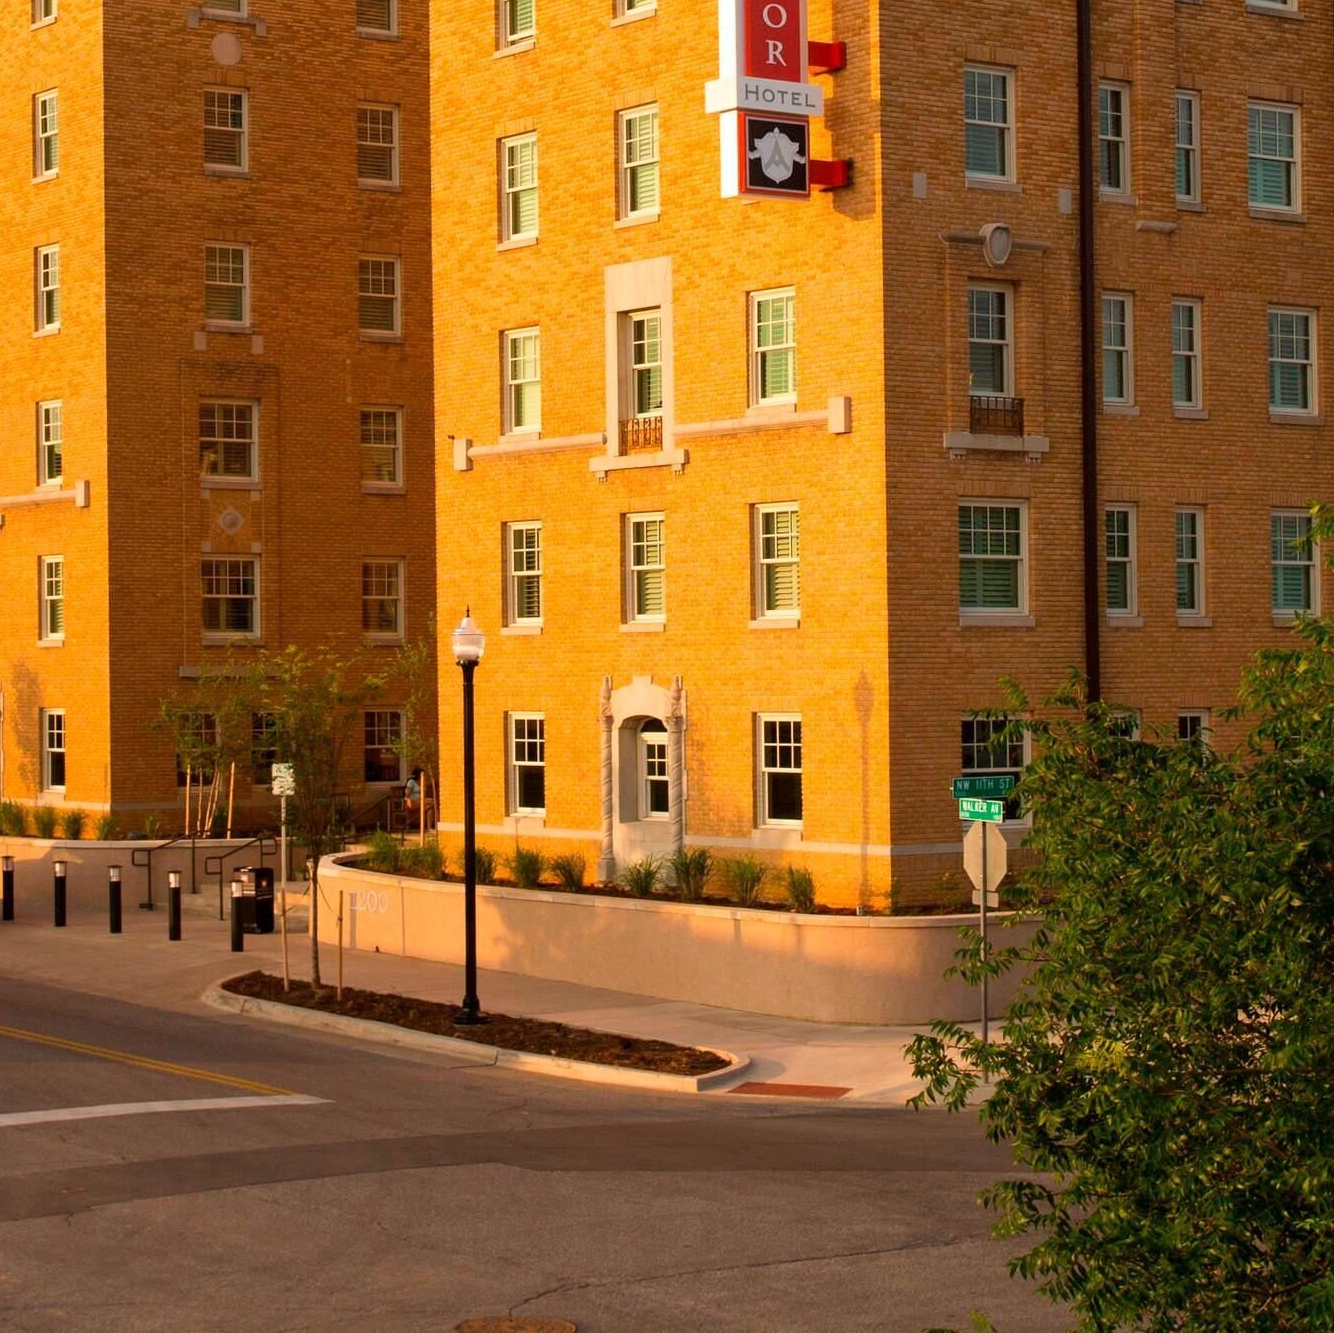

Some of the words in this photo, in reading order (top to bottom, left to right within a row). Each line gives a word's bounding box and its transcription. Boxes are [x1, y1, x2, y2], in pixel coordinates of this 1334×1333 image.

[744, 83, 816, 108] HOTEL
[957, 780, 970, 791] NW
[975, 778, 994, 790] 11TH
[999, 778, 1010, 789] ST
